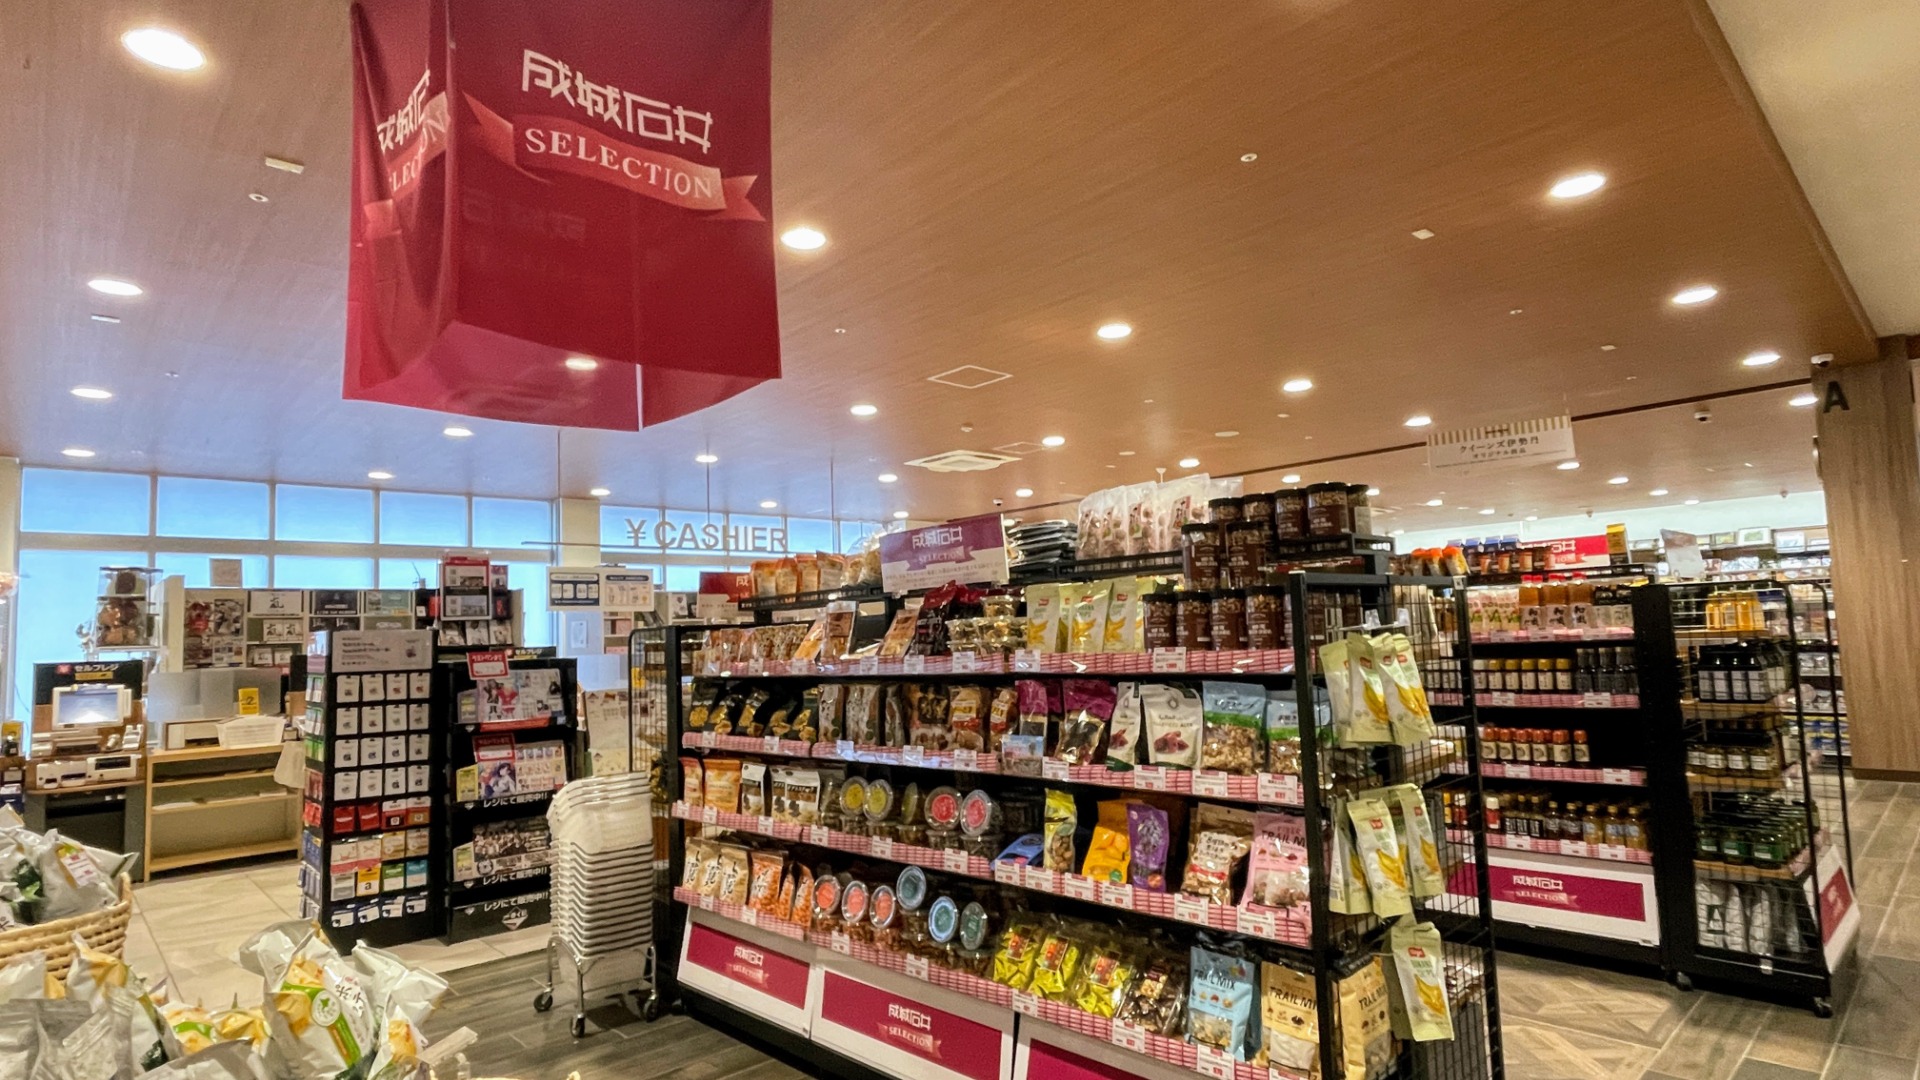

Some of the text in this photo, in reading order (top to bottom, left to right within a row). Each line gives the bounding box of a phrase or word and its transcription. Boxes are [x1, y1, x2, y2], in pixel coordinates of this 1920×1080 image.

[522, 49, 713, 153] 成城石井
[525, 128, 713, 200] SELECTION
[1823, 381, 1850, 413] A
[1460, 436, 1539, 453] クイーンズ伊勢丹
[653, 521, 788, 551] CASHIER
[912, 526, 963, 549] 成城石井
[74, 663, 119, 672] セルフレジ
[1512, 875, 1564, 890] 成城石井
[1270, 986, 1298, 1005] TRAIL
[1299, 996, 1317, 1010] MI
[888, 1003, 931, 1032] 成城石井
[888, 1026, 932, 1047] SELECTION
